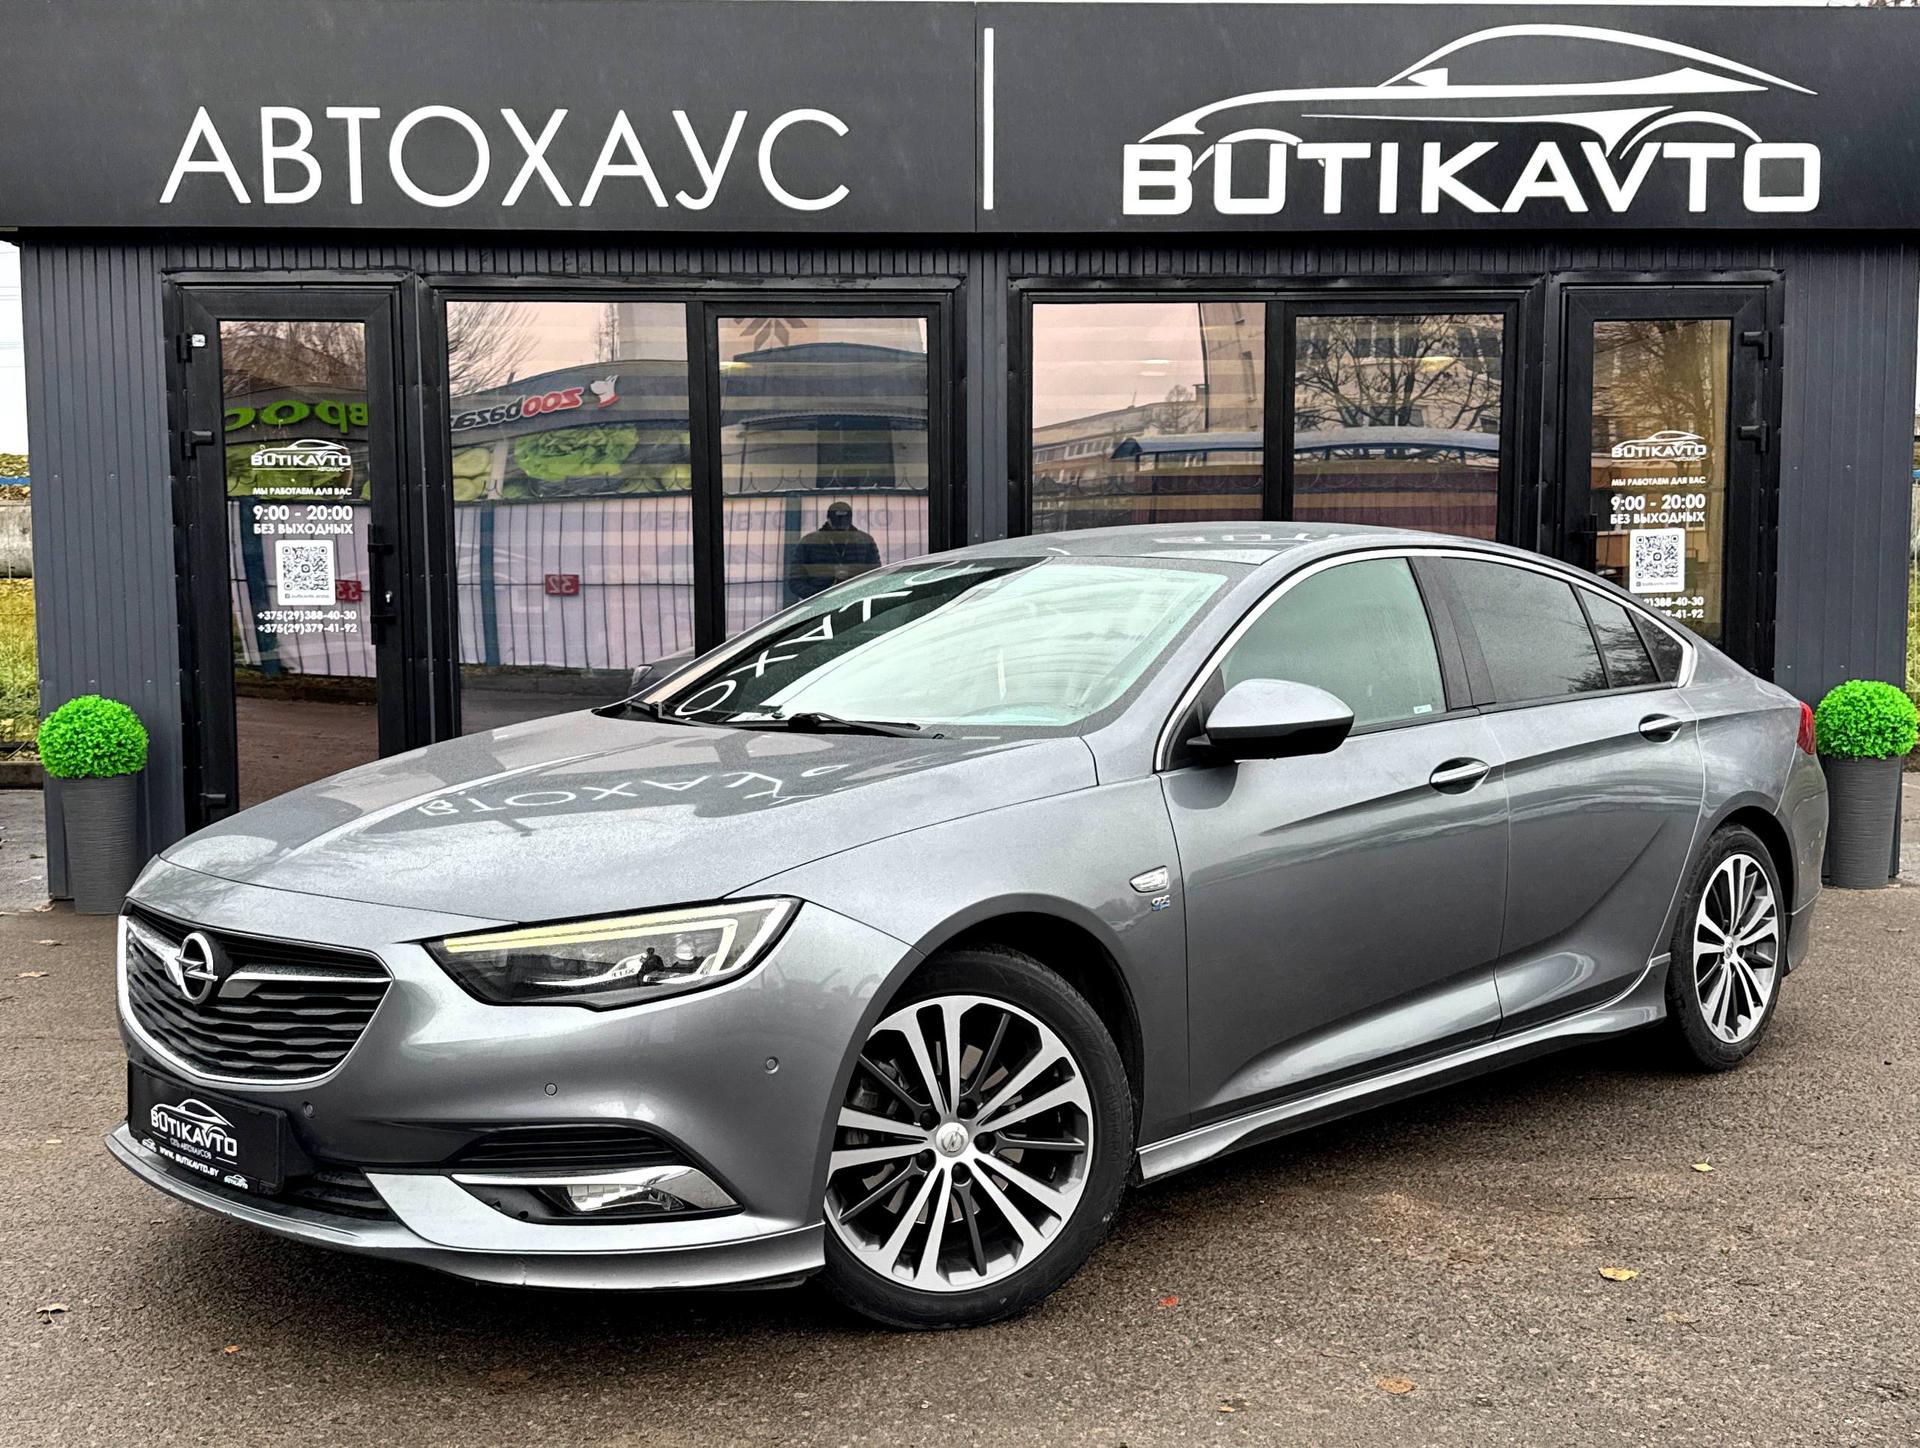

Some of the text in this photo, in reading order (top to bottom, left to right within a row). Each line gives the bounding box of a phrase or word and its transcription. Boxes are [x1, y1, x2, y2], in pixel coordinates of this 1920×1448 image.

[159, 104, 851, 211] АВТОХАУС
[1123, 140, 1820, 216] BUTIKAVTO
[1611, 445, 1707, 458] BUTIKAVTO
[251, 454, 352, 466] BUTIKAVTO
[1611, 476, 1706, 487] МЫ РАБОТАЕМ ДЛЯ ВАС
[252, 487, 352, 496] МЫ РАБОТАЕМ ДЛЯ ВАС
[1610, 496, 1645, 511] 9:00
[1661, 494, 1706, 510] 20:00
[252, 505, 290, 521] 9:00
[306, 505, 353, 521] 20:00
[1610, 511, 1705, 525] БЕЗ ВЫХОДНЫХ
[253, 523, 354, 535] БЕЗ ВЫХОДНЫХ
[257, 610, 357, 622] +375(29)388-40-30
[1661, 609, 1704, 619] 9-41-92
[257, 623, 358, 635] +375(29)379-41-92
[151, 1108, 238, 1157] BUTIKAVTO
